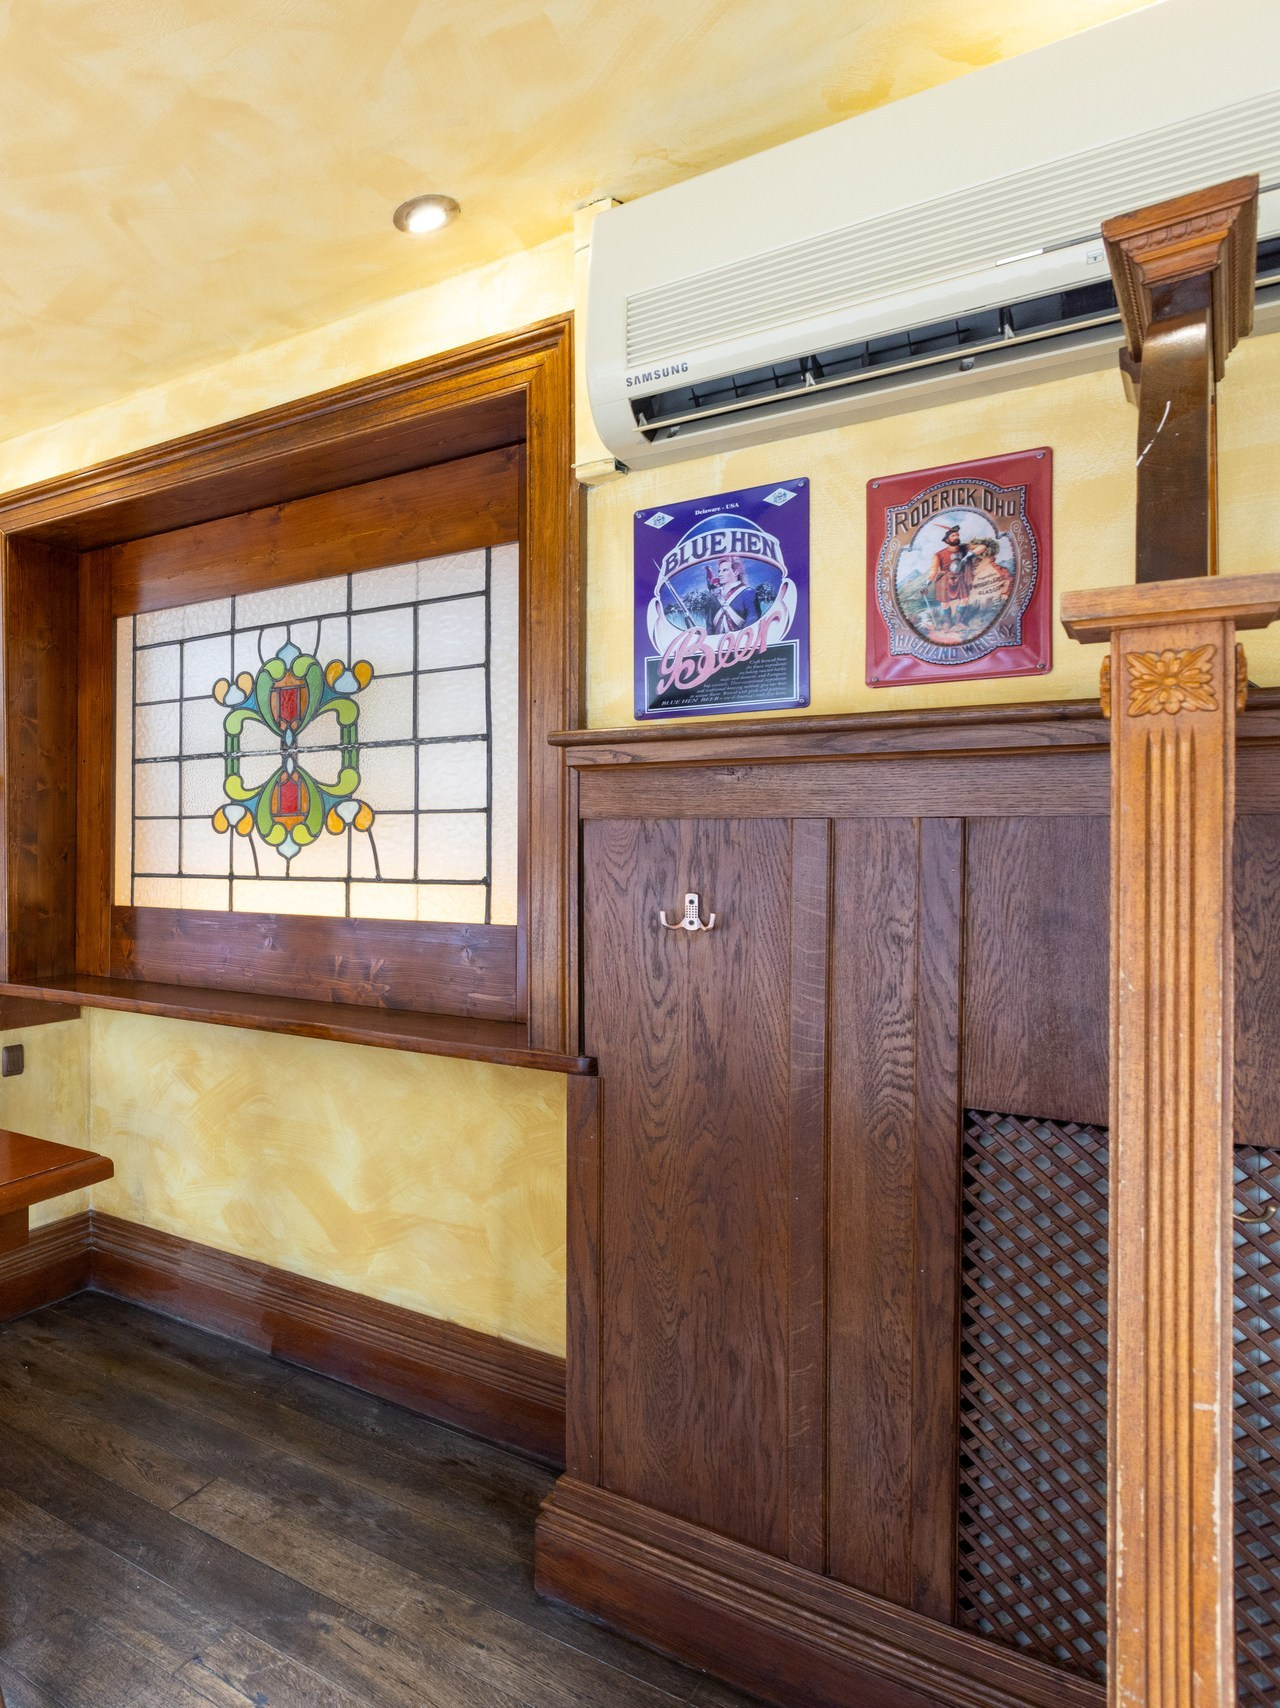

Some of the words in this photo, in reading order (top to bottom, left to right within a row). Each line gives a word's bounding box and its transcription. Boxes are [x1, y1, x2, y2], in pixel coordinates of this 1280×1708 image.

[626, 362, 689, 387] SAMSUNG
[694, 506, 721, 516] Delaware
[726, 502, 740, 510] USA
[892, 487, 978, 536] RODERICK
[982, 488, 1017, 517] DHU
[664, 531, 727, 576] BLUE
[730, 530, 780, 564] HEN
[656, 612, 783, 696] Beer
[895, 634, 959, 660] HIGHLAND
